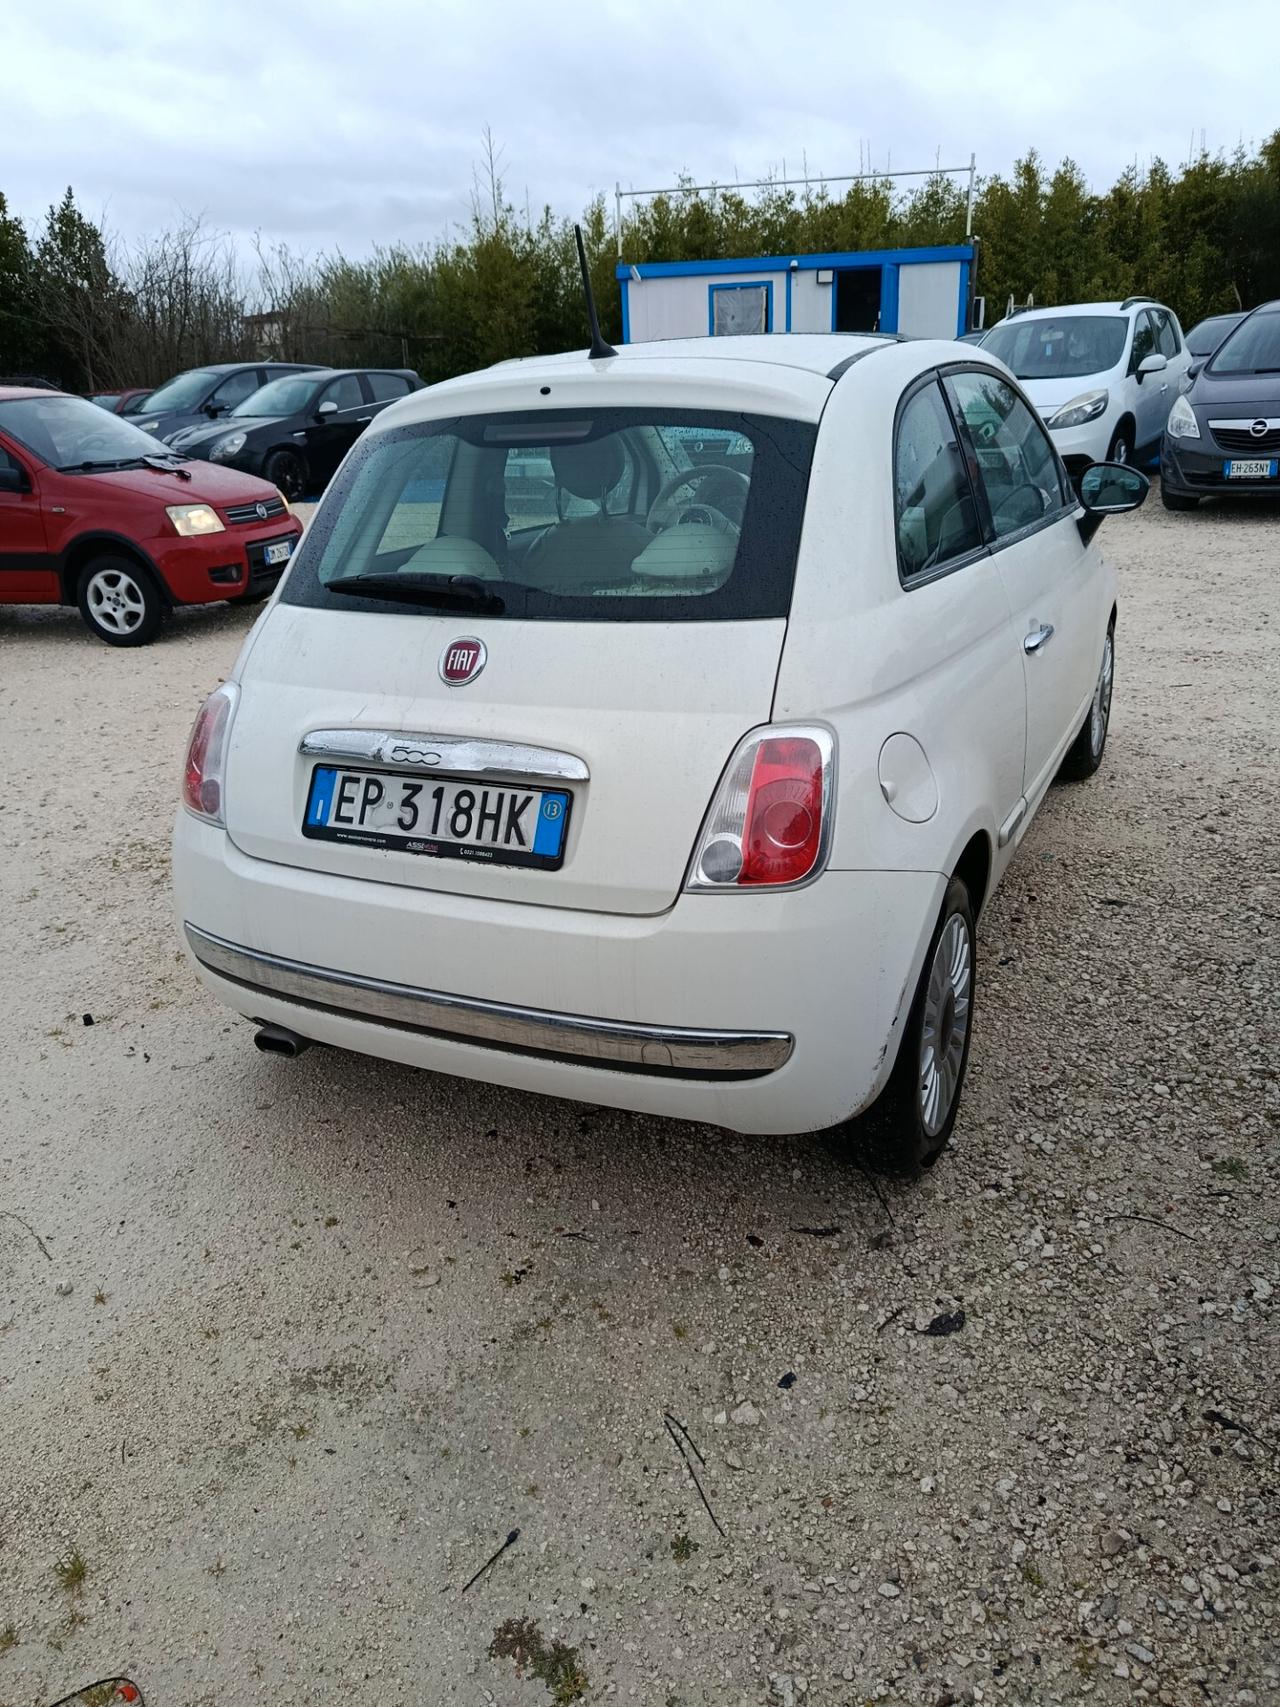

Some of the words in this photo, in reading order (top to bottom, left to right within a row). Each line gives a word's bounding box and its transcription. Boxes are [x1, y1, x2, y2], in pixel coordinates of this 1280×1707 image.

[447, 649, 477, 671] FIAT
[391, 746, 442, 766] 500
[334, 775, 384, 825] EP
[397, 782, 534, 847] 318HK
[546, 803, 558, 816] 13
